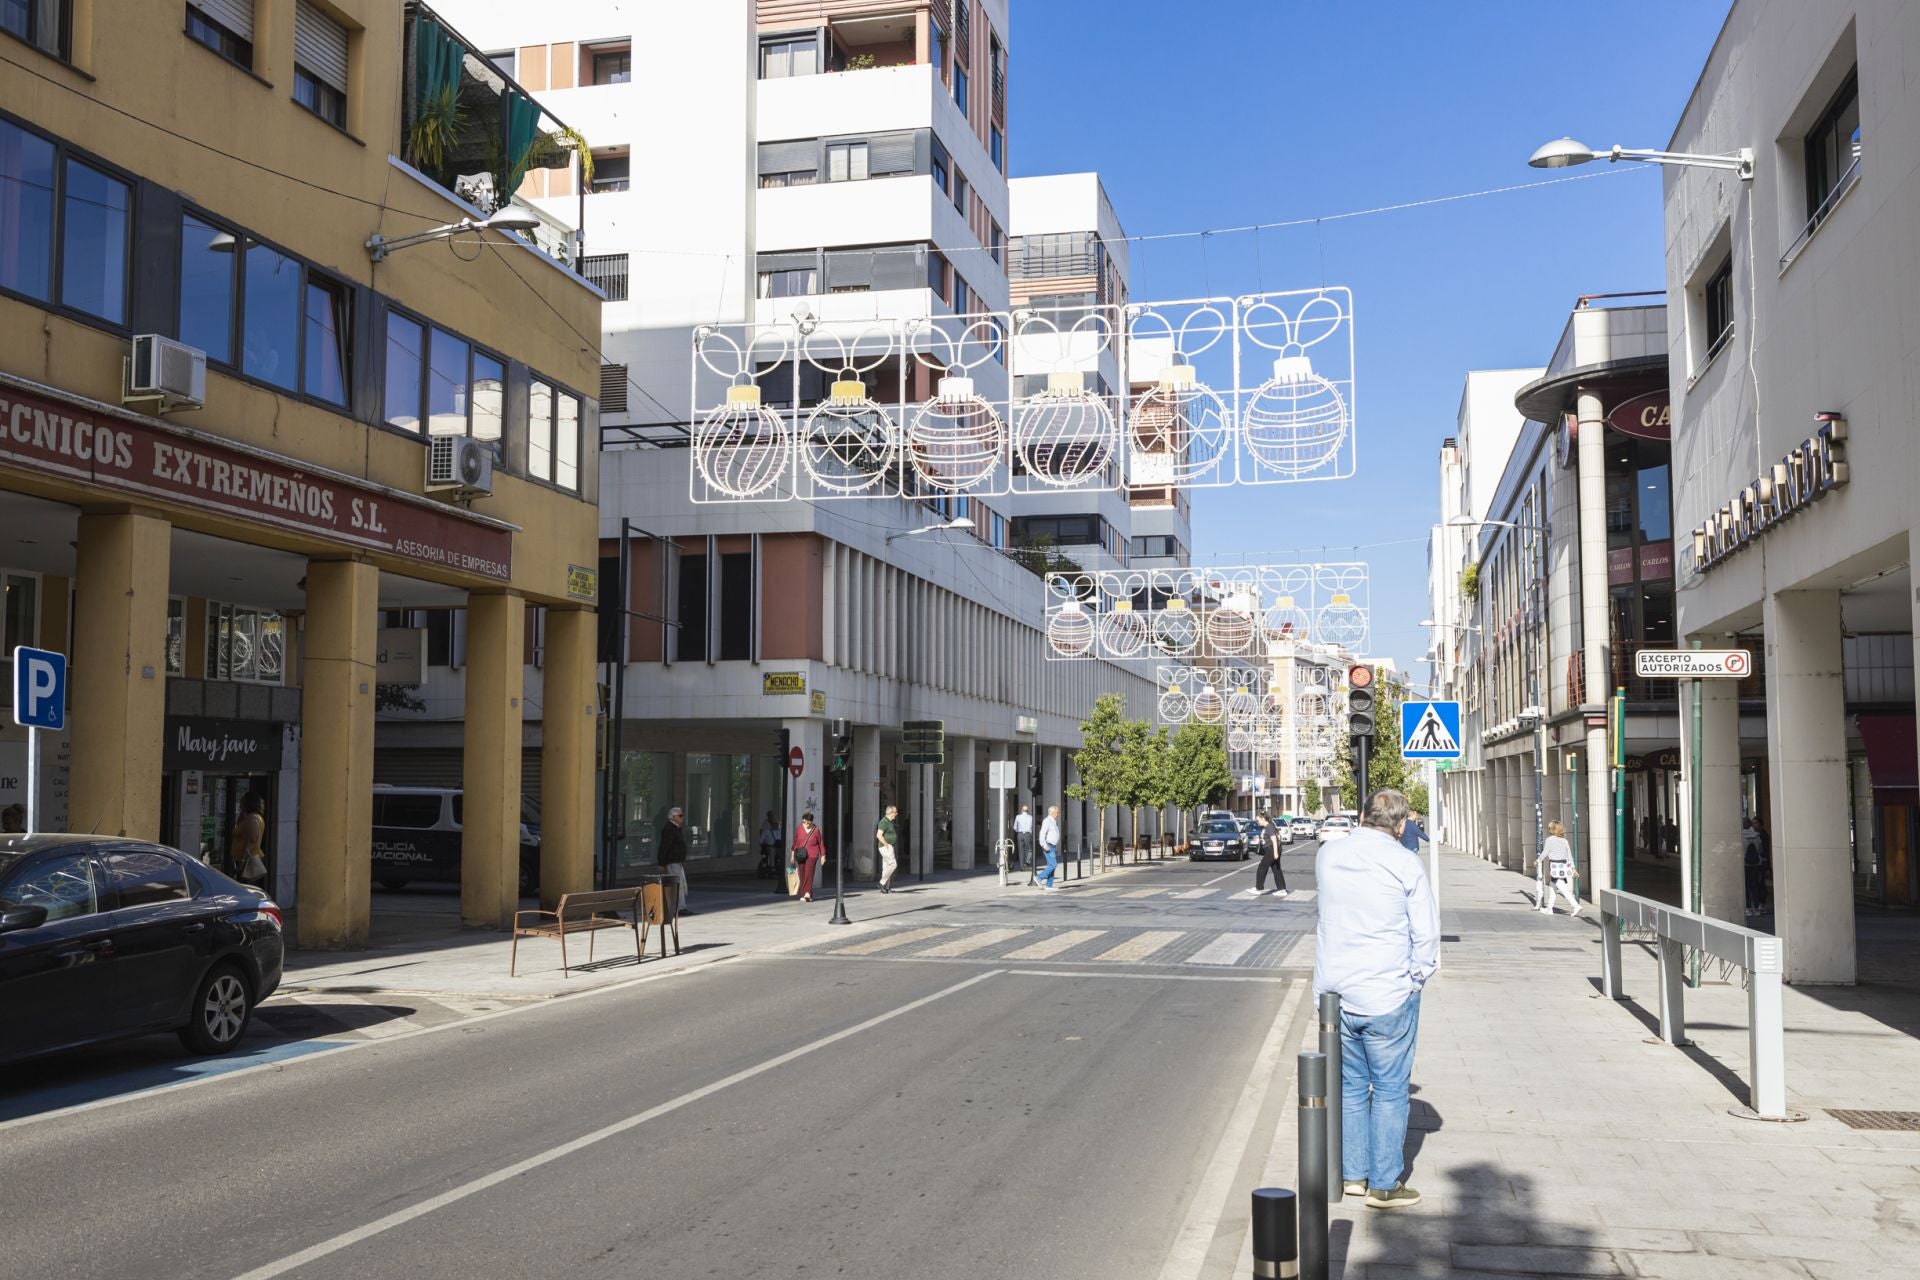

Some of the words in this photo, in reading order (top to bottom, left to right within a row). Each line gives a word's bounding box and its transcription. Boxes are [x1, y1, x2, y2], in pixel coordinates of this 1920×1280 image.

[153, 441, 338, 524] EXTREMEÑOS,
[351, 497, 387, 534] S.L.
[396, 538, 446, 562] ASESORIA
[447, 550, 461, 566] DE
[462, 555, 508, 578] EMPRESAS
[1642, 557, 1669, 567] CARLOS
[1609, 563, 1631, 572] CARLOS
[1641, 654, 1692, 663] EXCEPTO
[1641, 663, 1722, 672] AUTORIZADOS
[770, 676, 799, 687] MENACHO
[28, 658, 57, 717] P
[178, 726, 222, 761] Mary
[219, 734, 258, 761] jane
